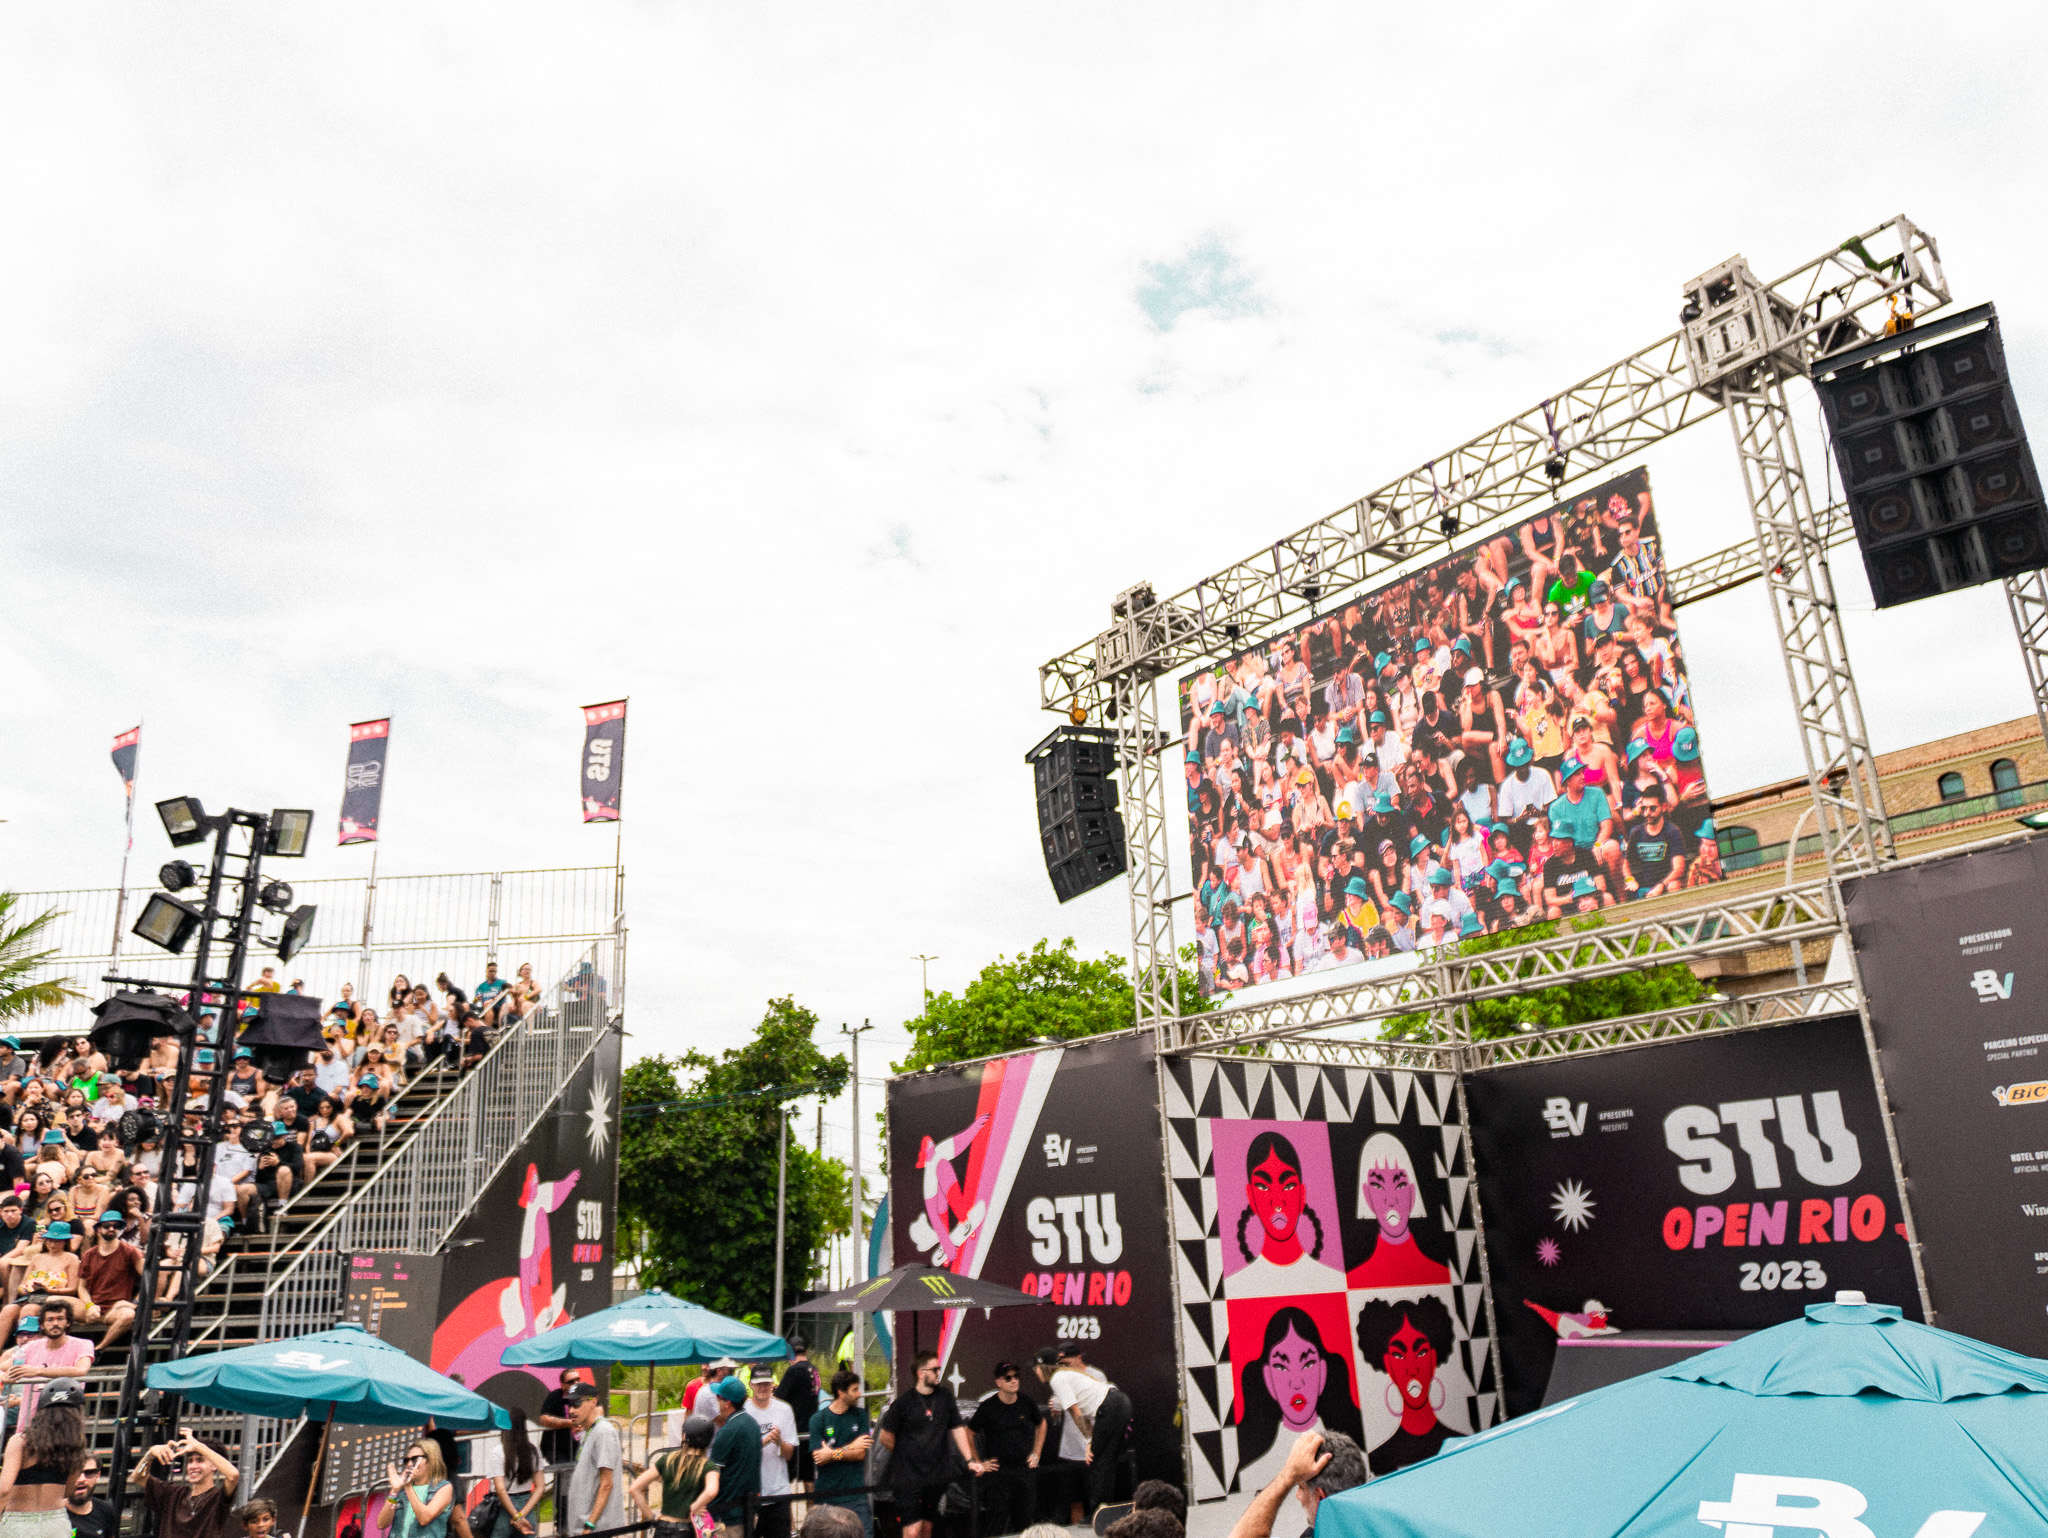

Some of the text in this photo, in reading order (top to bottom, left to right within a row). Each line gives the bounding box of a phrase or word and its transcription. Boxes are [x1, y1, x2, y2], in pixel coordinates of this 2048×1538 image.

[1959, 927, 2012, 945] APRESENTADOR
[1962, 942, 2003, 956] PRESENTED BY
[1970, 969, 2014, 1000] BV
[1987, 1047, 2039, 1061] SPECIAL PARTNER
[1542, 1097, 1588, 1136] BV
[1599, 1109, 1634, 1120] APRESENTA
[1601, 1122, 1629, 1133] PRESENTS
[1663, 1090, 1862, 1195] STU
[2010, 1151, 2035, 1162] HOTEL
[577, 1200, 602, 1240] STU
[1026, 1193, 1123, 1265] STU
[1663, 1194, 1886, 1250] OPEN RIO
[1021, 1270, 1132, 1306] OPEN RIO
[1739, 1260, 1828, 1291] 2023
[1057, 1316, 1101, 1339] 2023
